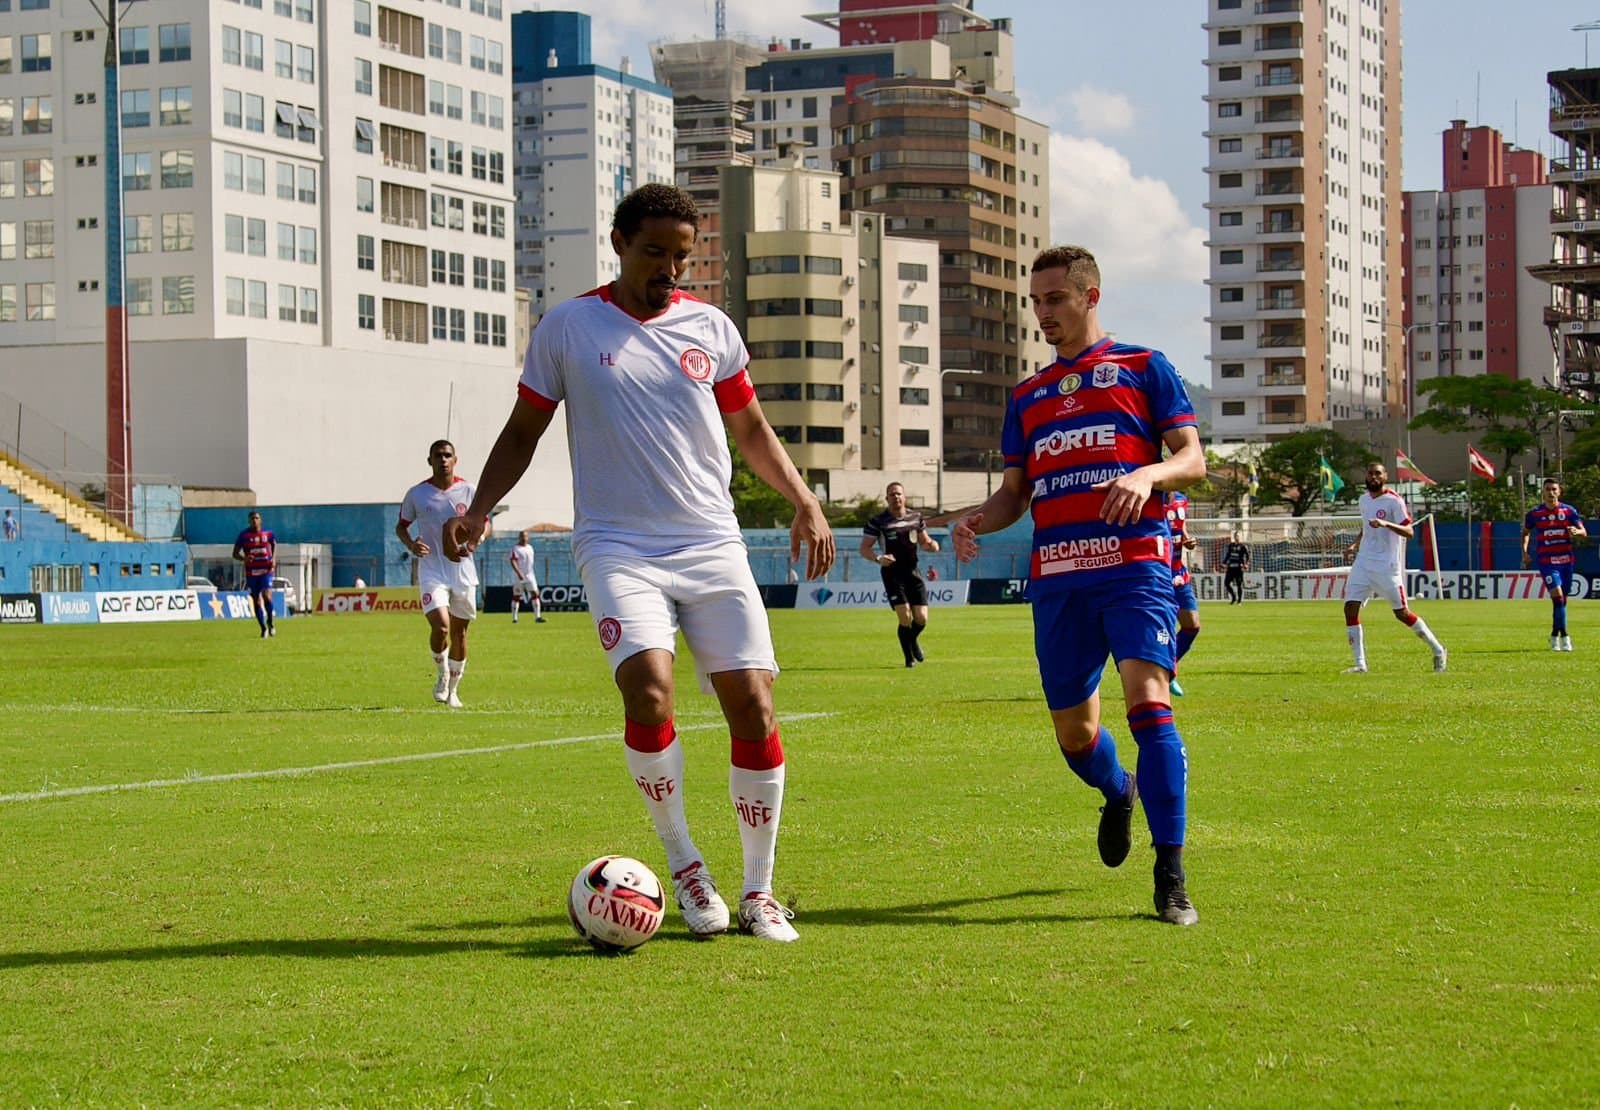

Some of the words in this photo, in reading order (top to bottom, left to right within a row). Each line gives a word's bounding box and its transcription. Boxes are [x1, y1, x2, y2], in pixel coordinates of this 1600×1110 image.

[1034, 424, 1117, 461] FORTE
[1039, 536, 1121, 563] DECAPRIO
[1073, 554, 1122, 568] SEGUROS
[101, 597, 131, 613] ADF
[136, 596, 164, 612] ADF
[168, 595, 195, 611] ADF
[374, 600, 422, 611] ATACA
